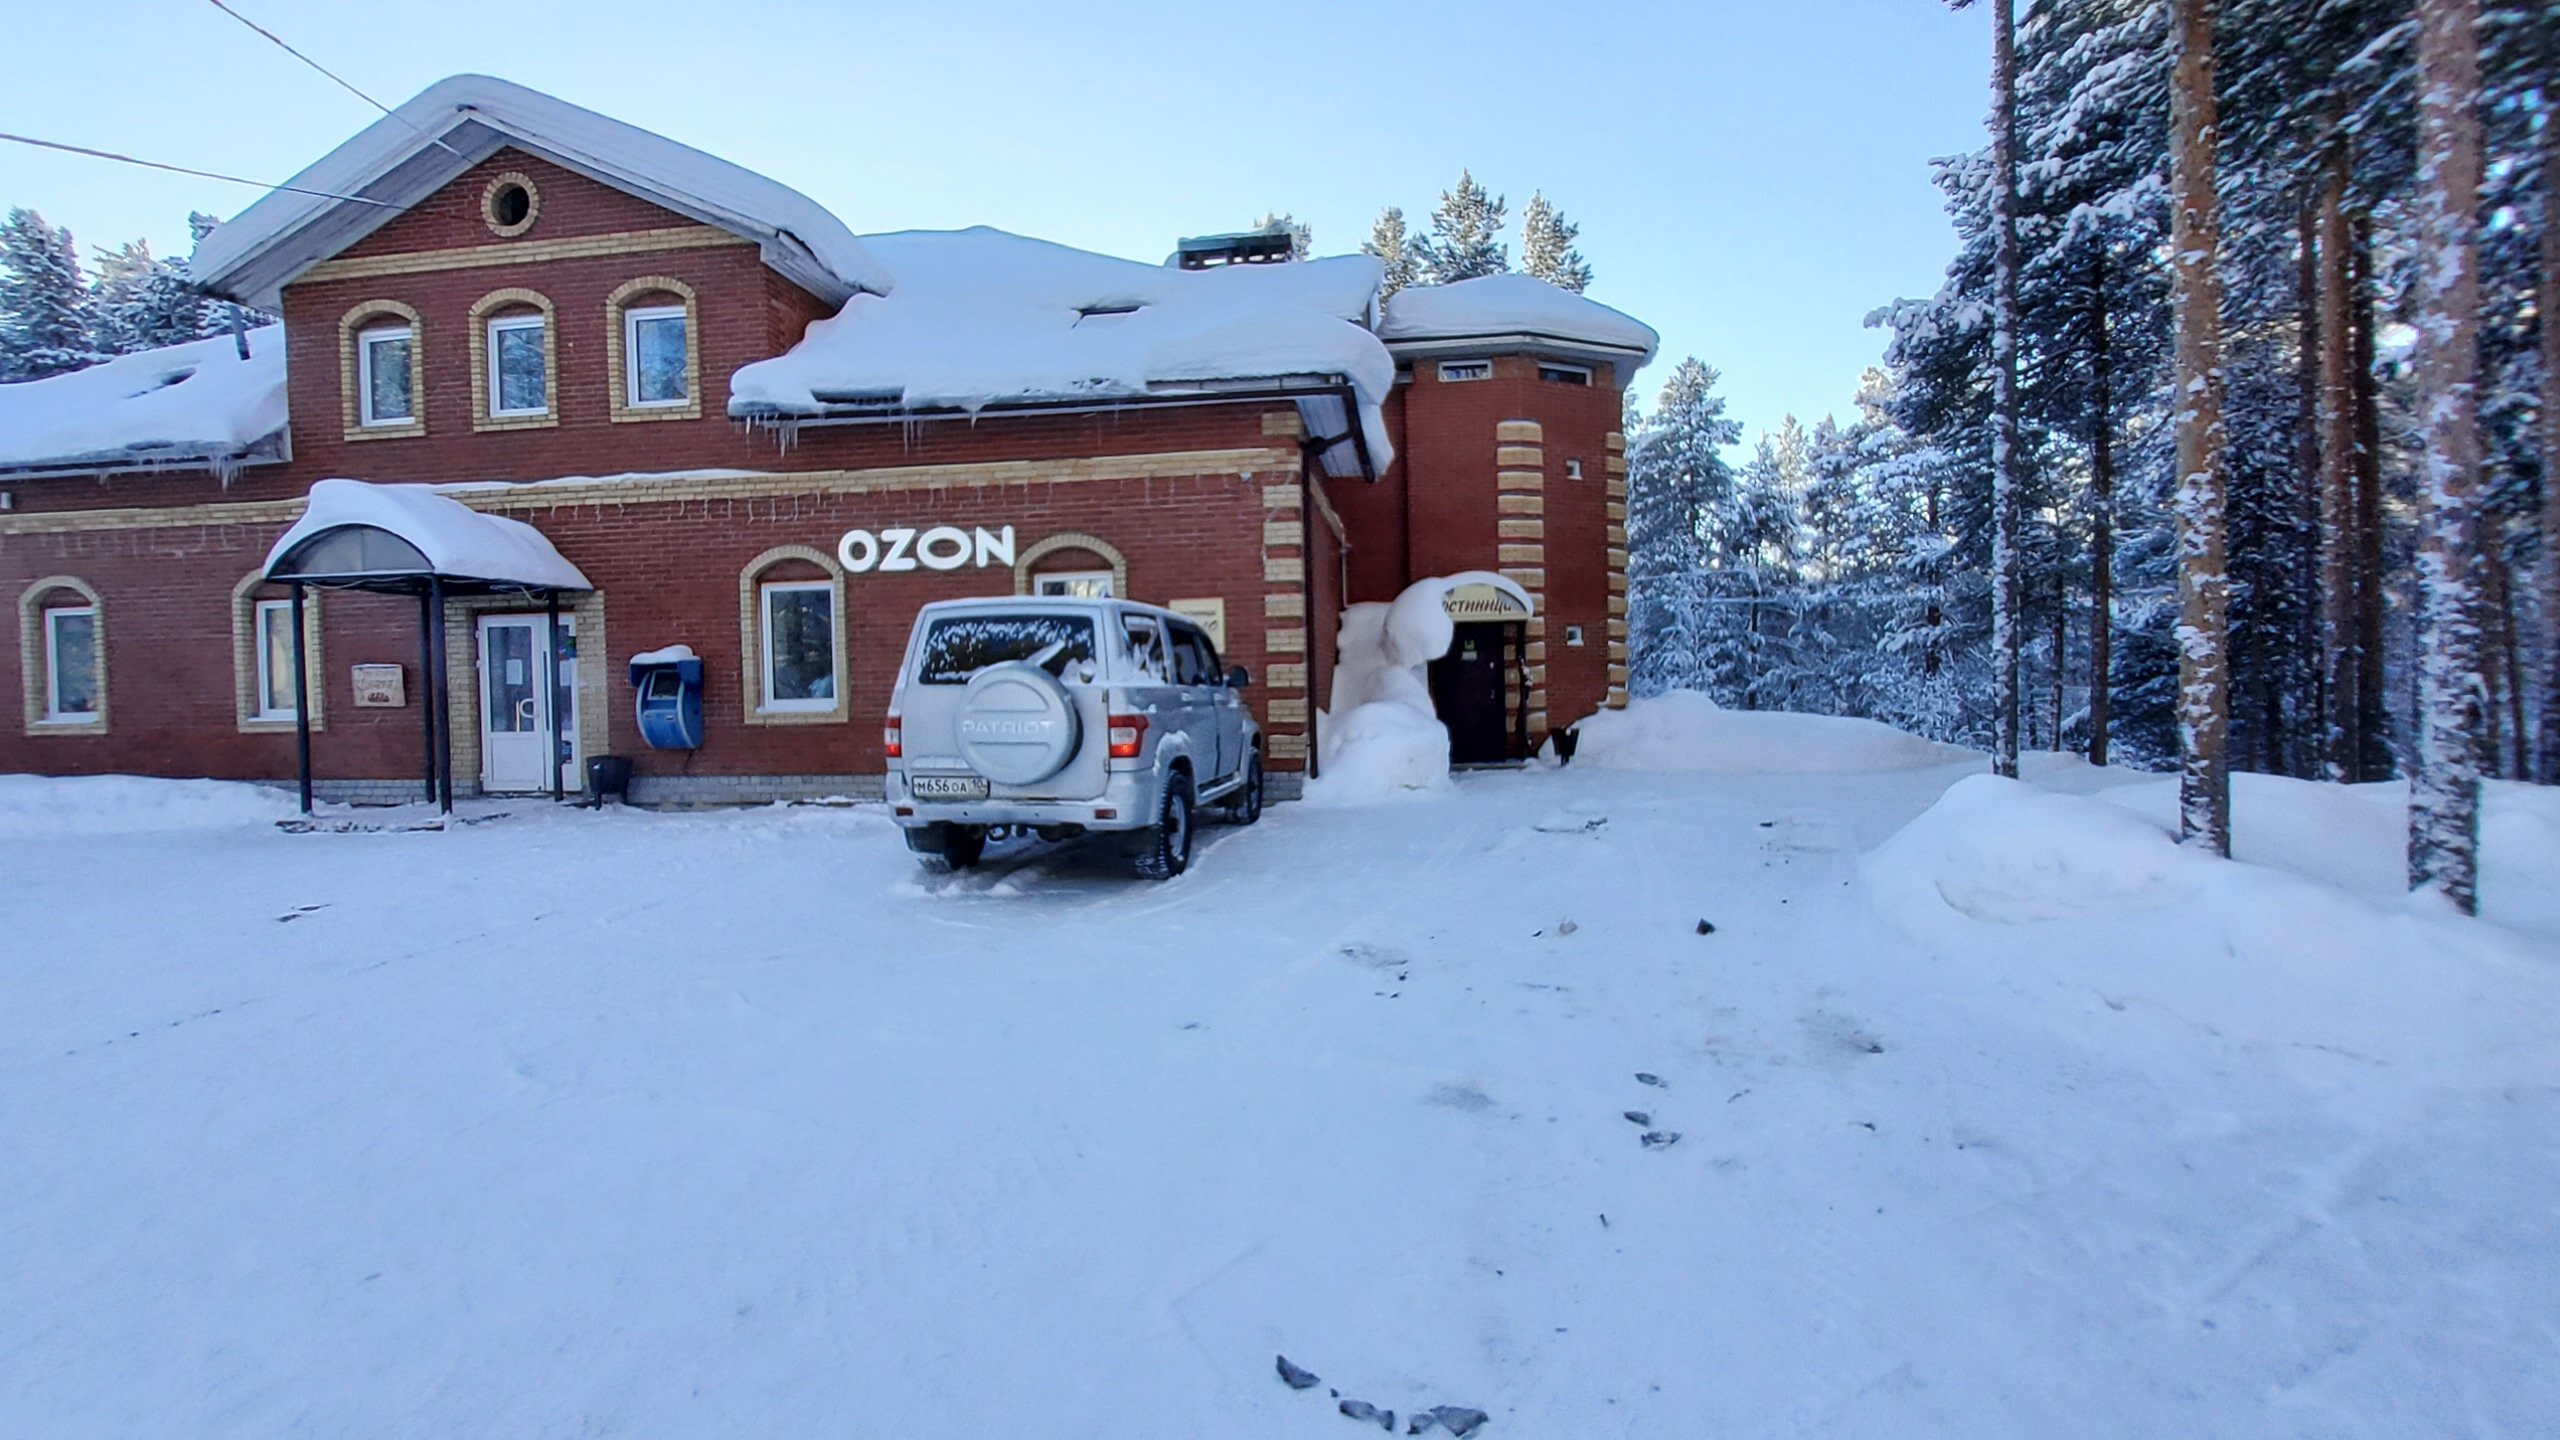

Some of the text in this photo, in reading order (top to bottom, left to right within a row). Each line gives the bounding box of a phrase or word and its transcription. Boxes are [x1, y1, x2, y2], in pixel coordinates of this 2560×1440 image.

[838, 525, 1015, 573] OZON
[1442, 599, 1512, 615] остиница
[962, 720, 1054, 733] PATRIOT
